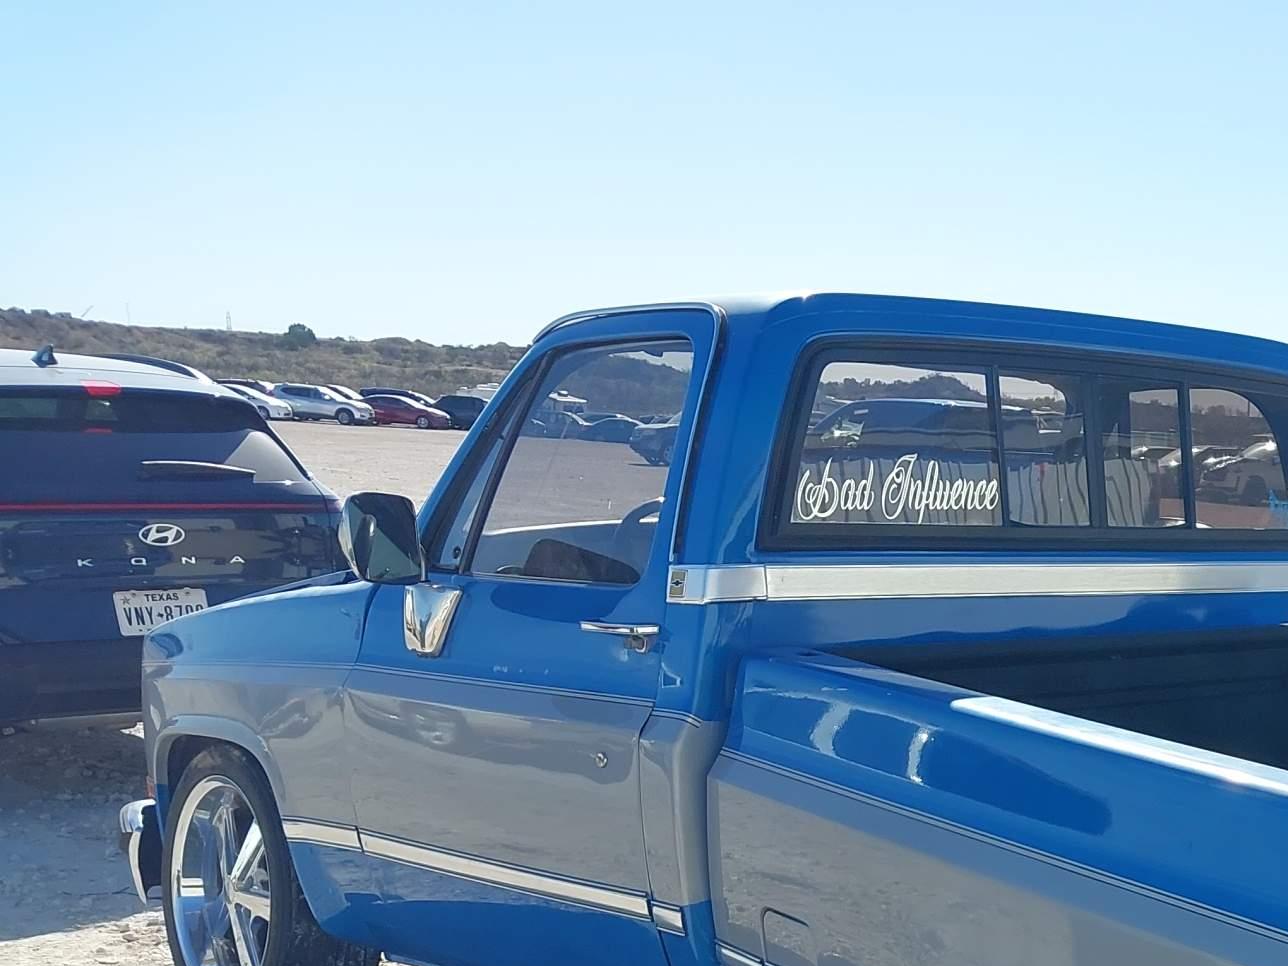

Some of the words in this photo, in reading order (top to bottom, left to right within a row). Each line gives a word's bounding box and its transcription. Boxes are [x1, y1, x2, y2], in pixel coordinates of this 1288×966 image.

[882, 453, 999, 524] Influence
[77, 555, 246, 567] KONA
[144, 592, 179, 602] TEXAS
